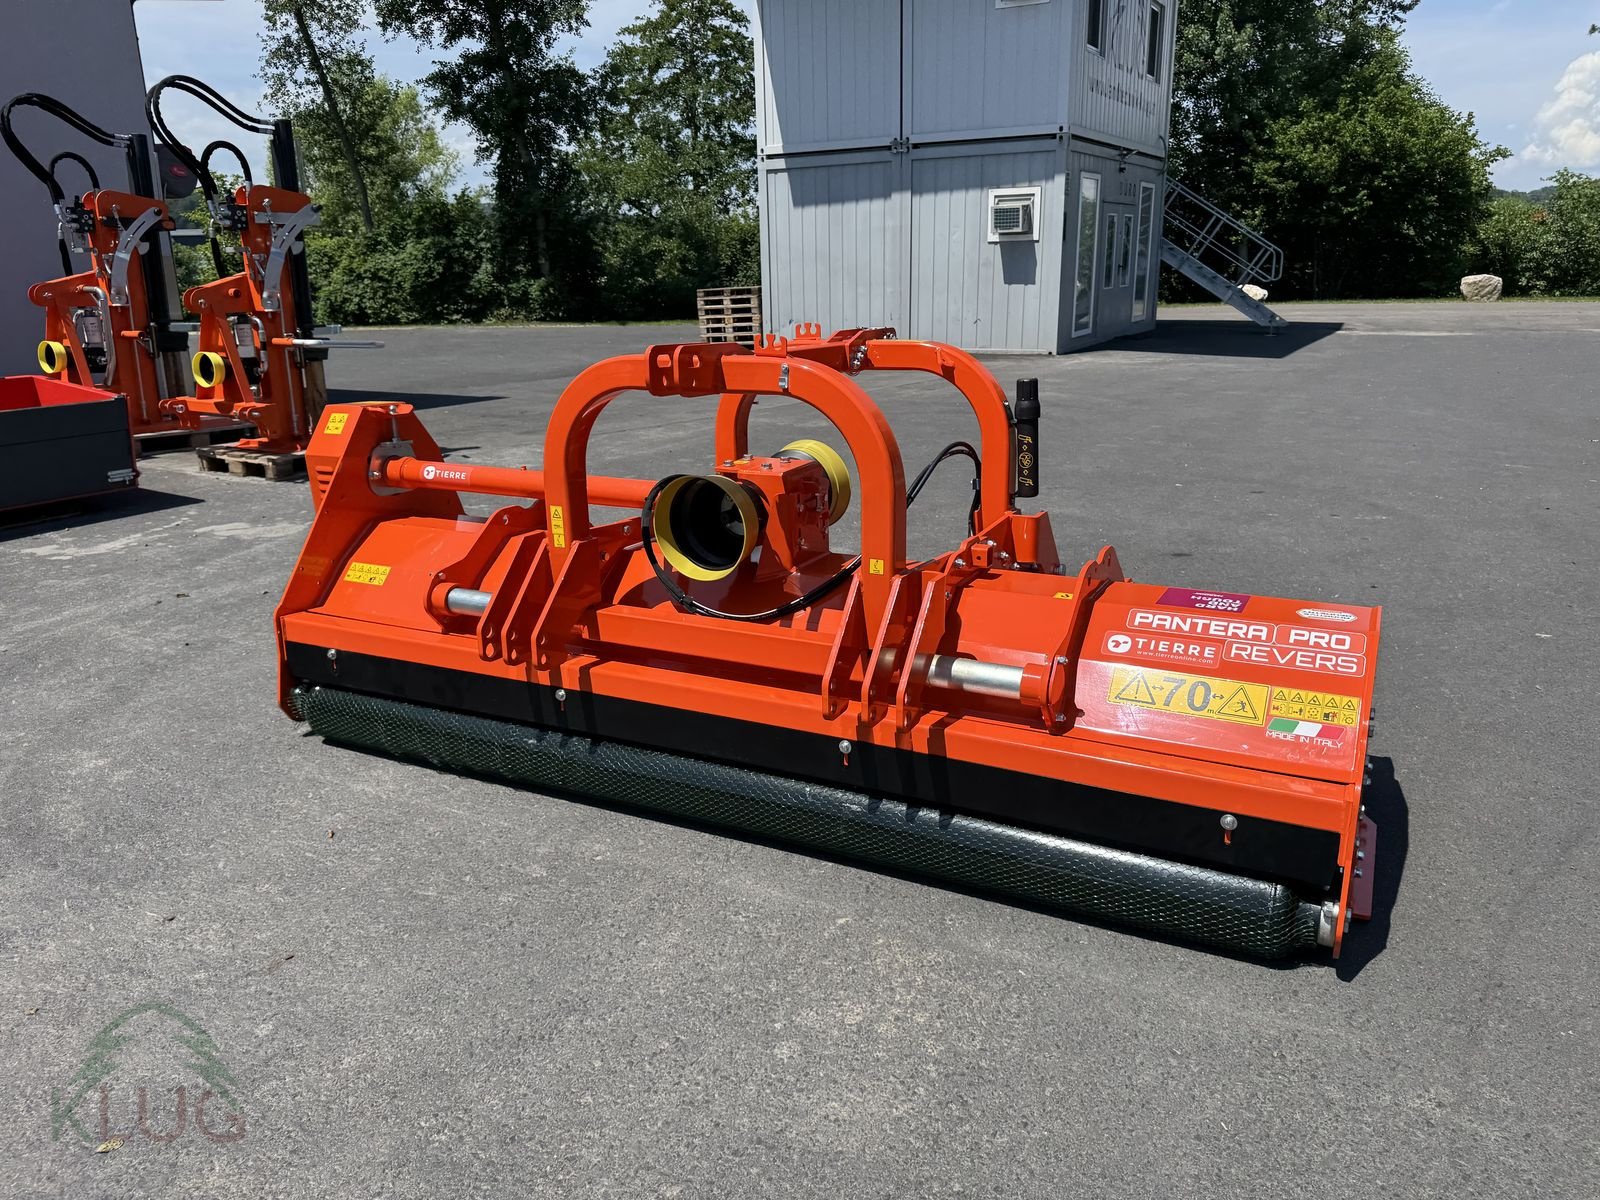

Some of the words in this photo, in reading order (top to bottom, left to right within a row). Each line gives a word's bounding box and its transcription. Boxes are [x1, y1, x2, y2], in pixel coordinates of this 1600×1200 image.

[436, 470, 467, 480] TIERRE
[1133, 612, 1268, 641] PANTERA
[1288, 629, 1351, 650] PRO
[1135, 637, 1216, 658] TIERRE
[1136, 650, 1213, 664] www.tierreonline.com
[1230, 643, 1357, 673] REVERS
[1163, 676, 1212, 712] 70
[1265, 730, 1296, 742] MADE
[1313, 737, 1344, 749] ITALY
